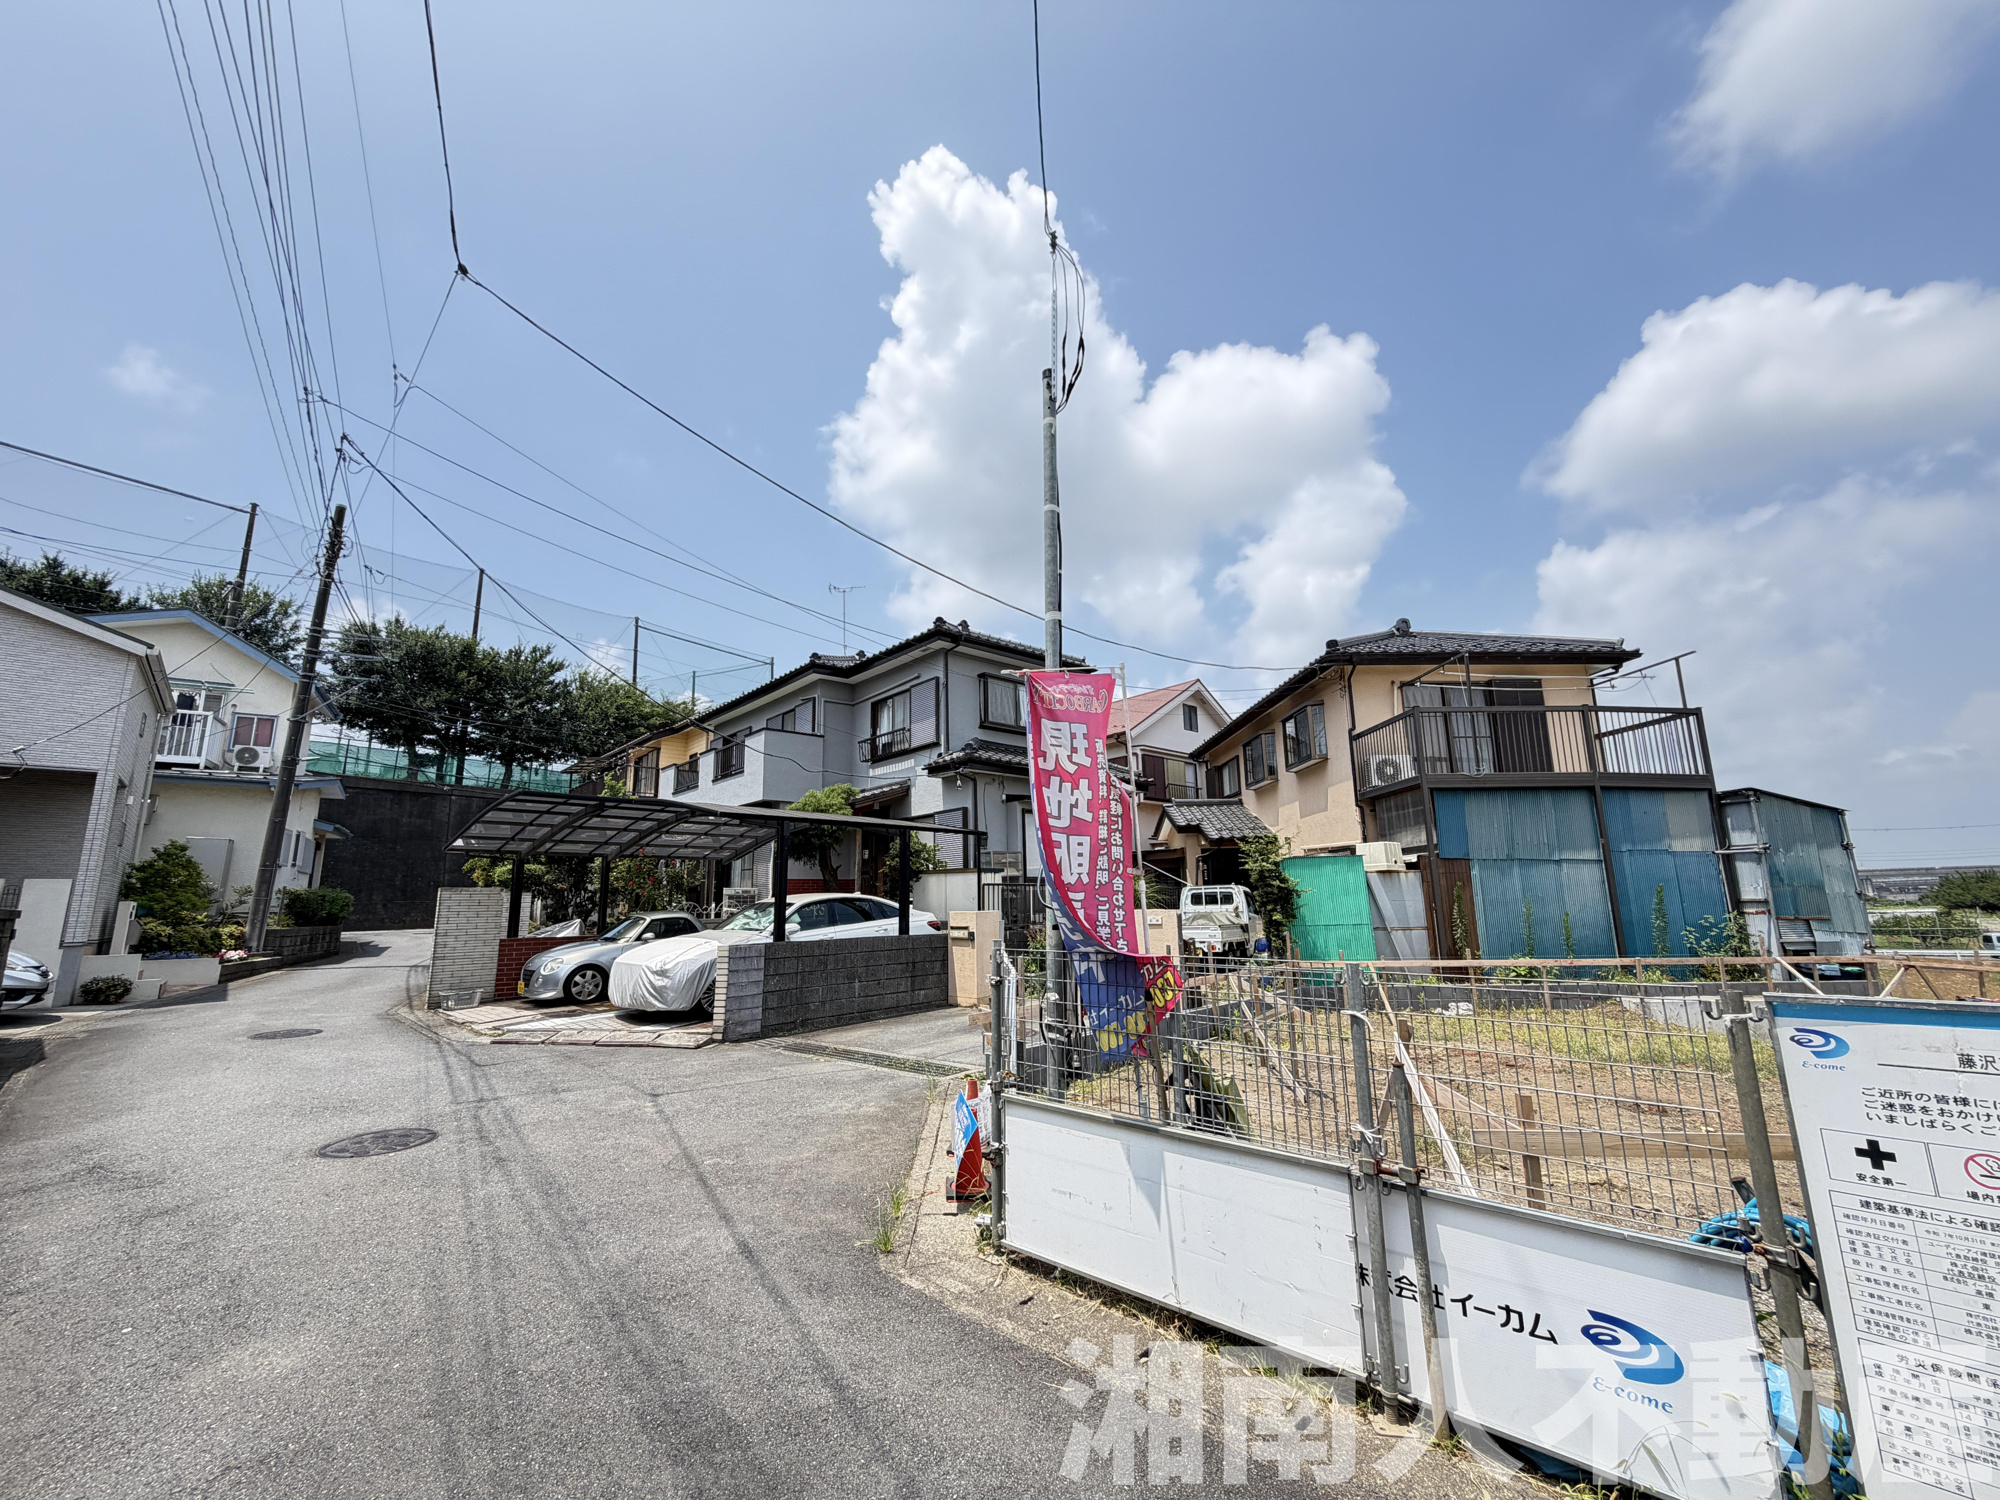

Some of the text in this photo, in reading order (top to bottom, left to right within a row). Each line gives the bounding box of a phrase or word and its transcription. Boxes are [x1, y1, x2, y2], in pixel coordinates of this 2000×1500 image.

[1957, 1053, 2000, 1071] 藤沢
[1856, 1172, 1907, 1187] 安全第一
[1966, 1190, 2000, 1204] 場内
